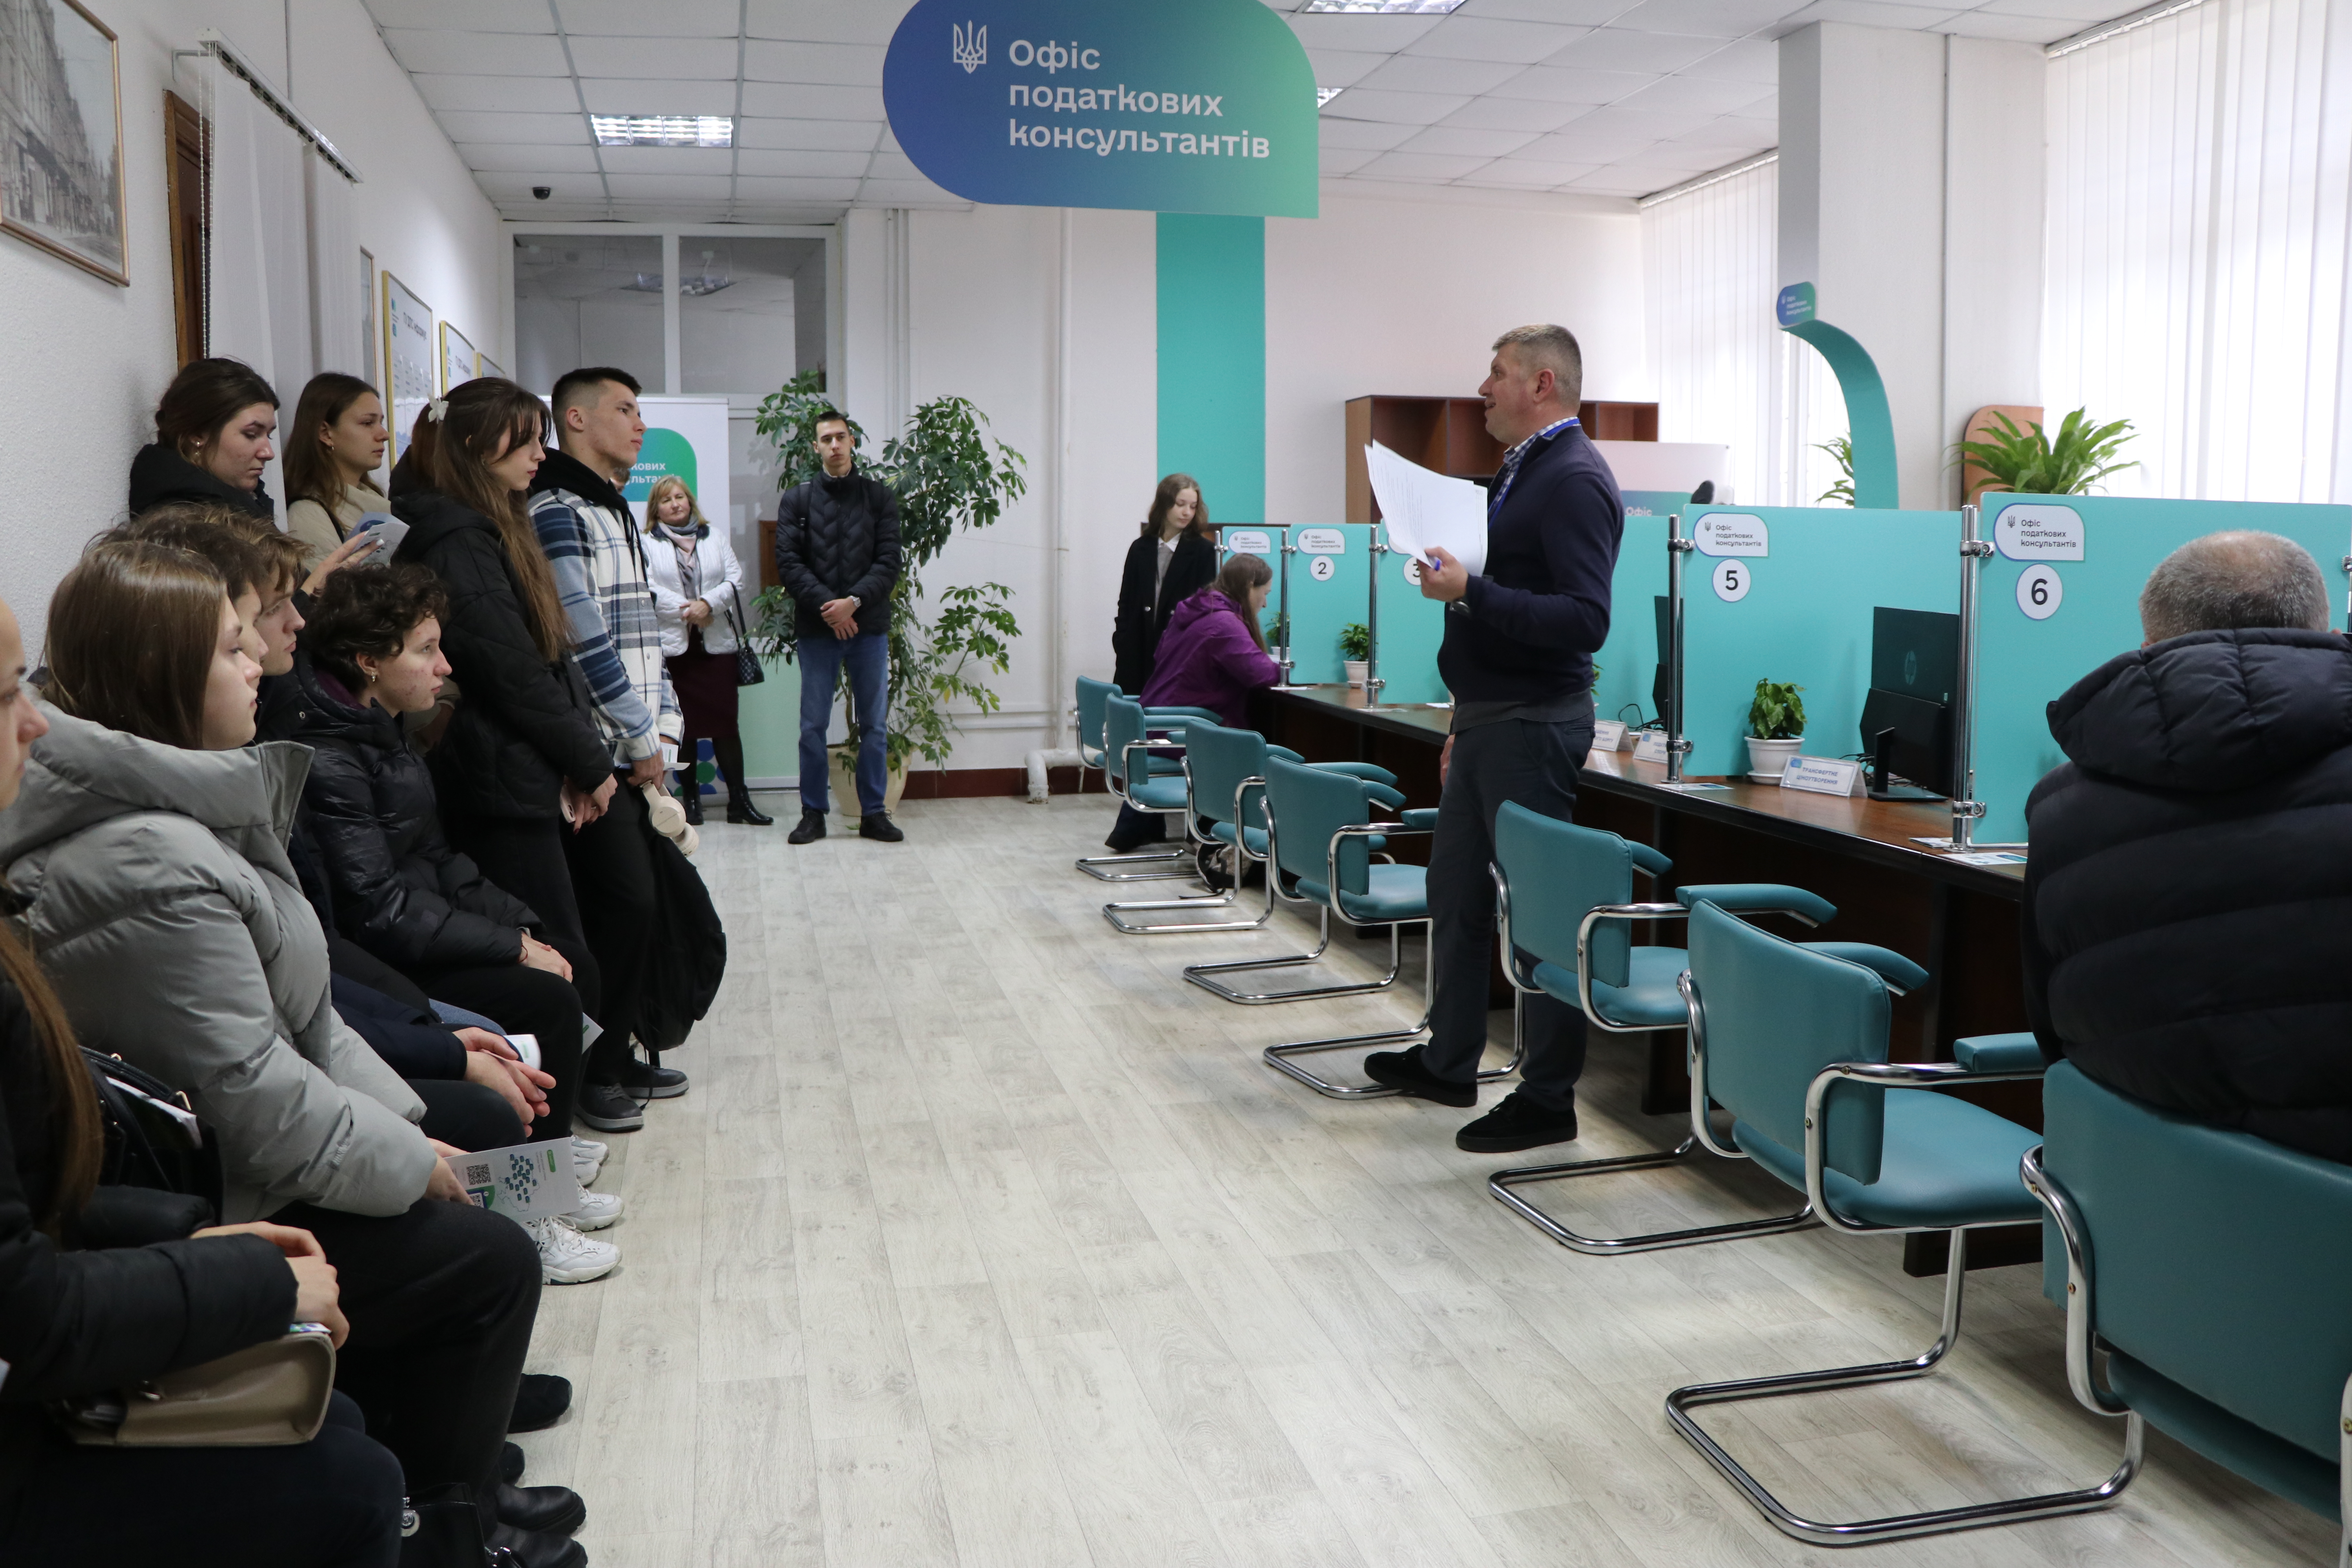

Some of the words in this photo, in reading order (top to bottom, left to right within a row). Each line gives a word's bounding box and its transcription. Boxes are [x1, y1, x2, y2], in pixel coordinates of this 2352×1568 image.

[1009, 40, 1100, 74] Офіс
[1010, 84, 1223, 116] податкових
[1010, 118, 1270, 157] консультантів
[1626, 506, 1652, 516] Офіс
[2021, 539, 2076, 548] консультантів
[1318, 562, 1327, 574] 2
[1413, 563, 1420, 577] 3
[1726, 570, 1738, 590] 5
[2031, 578, 2048, 605] 6
[1802, 767, 1838, 777] ТРАНСФЕРТНЕ
[1797, 775, 1838, 784] ЦІНОУТВОРЕННЯ
